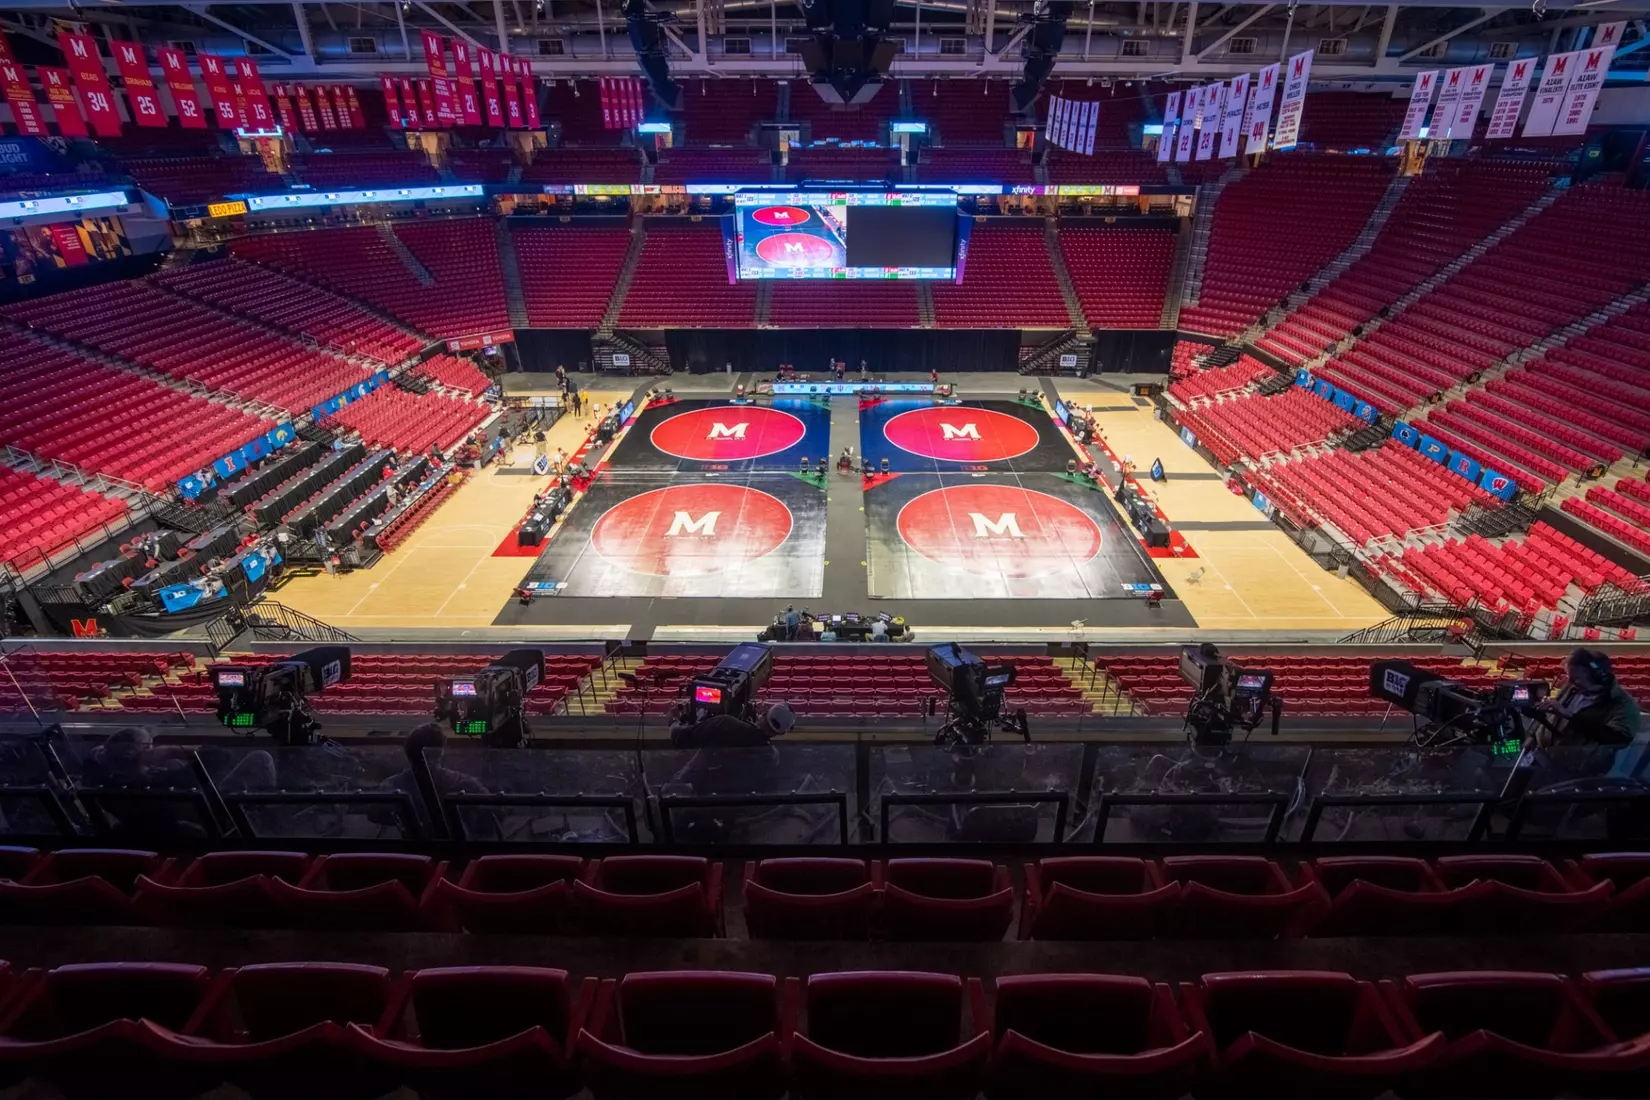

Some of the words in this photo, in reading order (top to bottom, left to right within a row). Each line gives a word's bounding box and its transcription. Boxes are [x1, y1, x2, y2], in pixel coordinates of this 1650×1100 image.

[1603, 26, 1616, 40] M
[70, 39, 88, 57] M
[121, 47, 137, 63] M
[167, 53, 180, 69] M
[206, 59, 219, 73] M
[241, 62, 252, 76] M
[1293, 57, 1304, 79] M
[1552, 57, 1568, 74] M
[1584, 52, 1602, 71] M
[3, 66, 19, 81] M
[47, 72, 61, 84] M
[1449, 71, 1461, 85] M
[1472, 68, 1485, 83] M
[1512, 62, 1528, 79] M
[1578, 74, 1598, 82] AIAW
[1263, 69, 1273, 90] M
[1421, 75, 1431, 88] M
[1545, 78, 1563, 86] AIAW
[1583, 82, 1600, 90] EIGHT
[88, 92, 109, 112] 34
[138, 97, 156, 115] 25
[181, 100, 198, 117] 52
[219, 102, 233, 118] 55
[465, 94, 475, 112] 21
[489, 98, 498, 115] 25
[510, 101, 518, 116] 35
[254, 104, 266, 119] 15
[530, 103, 535, 118] 3
[1227, 127, 1234, 146] 4
[1253, 121, 1264, 141] 44
[1181, 136, 1189, 151] 22
[1201, 132, 1210, 149] 23
[1011, 186, 1036, 196] xfinity
[209, 203, 227, 216] LEDO
[228, 201, 246, 214] PIZZA
[726, 238, 734, 260] xfinity
[784, 242, 805, 253] M
[959, 239, 967, 260] xfinity
[706, 422, 750, 439] M
[939, 423, 983, 439] M
[1427, 443, 1441, 454] P
[1459, 458, 1471, 475] R
[1492, 477, 1510, 492] W
[664, 511, 723, 536] M
[967, 512, 1027, 537] M
[70, 618, 98, 638] M
